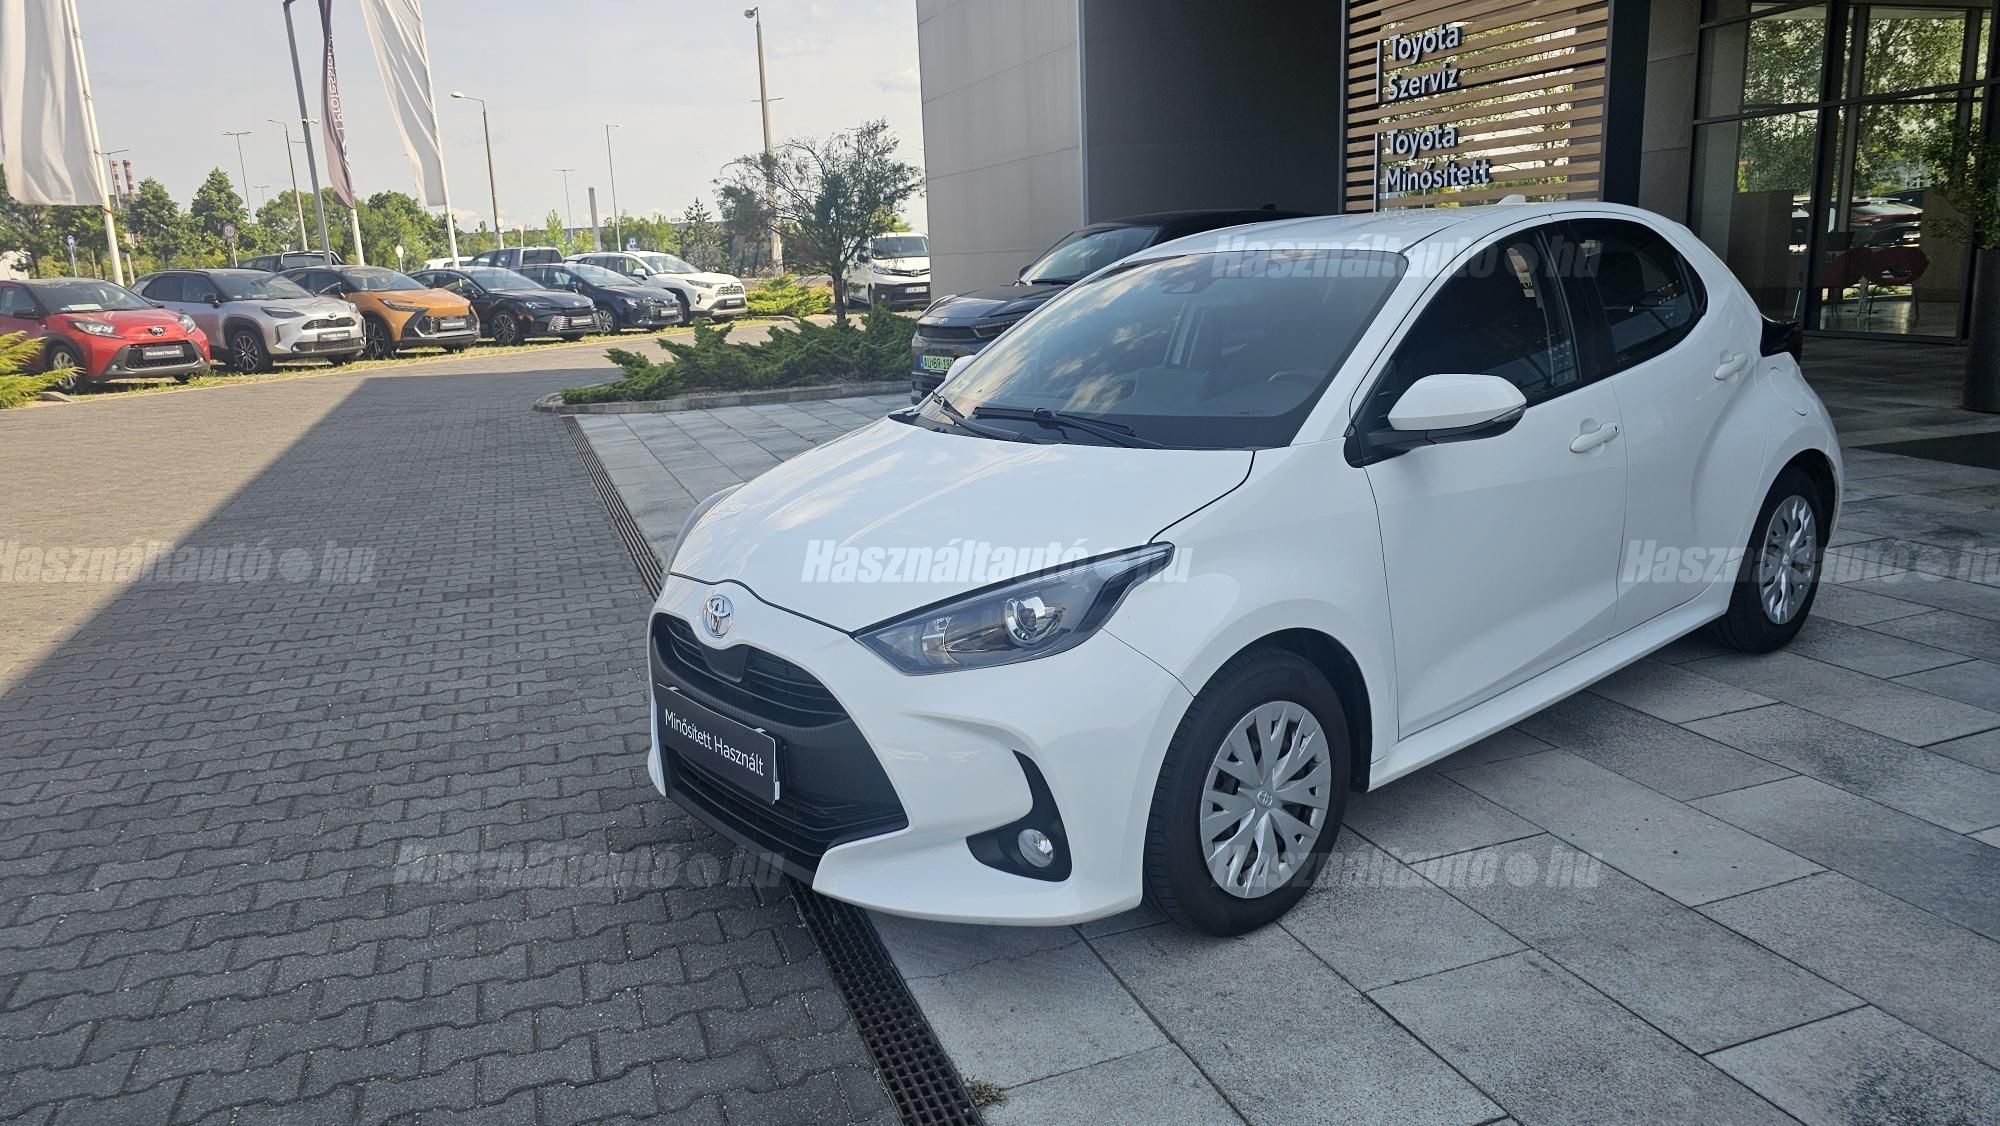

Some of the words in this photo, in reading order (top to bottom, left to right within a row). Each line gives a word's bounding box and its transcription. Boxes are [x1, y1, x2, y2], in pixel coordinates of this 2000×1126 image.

[1388, 25, 1461, 64] Toyota
[1386, 126, 1457, 160] Toyota
[1385, 160, 1491, 191] Minősített
[665, 708, 712, 750] Minősített
[714, 736, 764, 776] Használt
